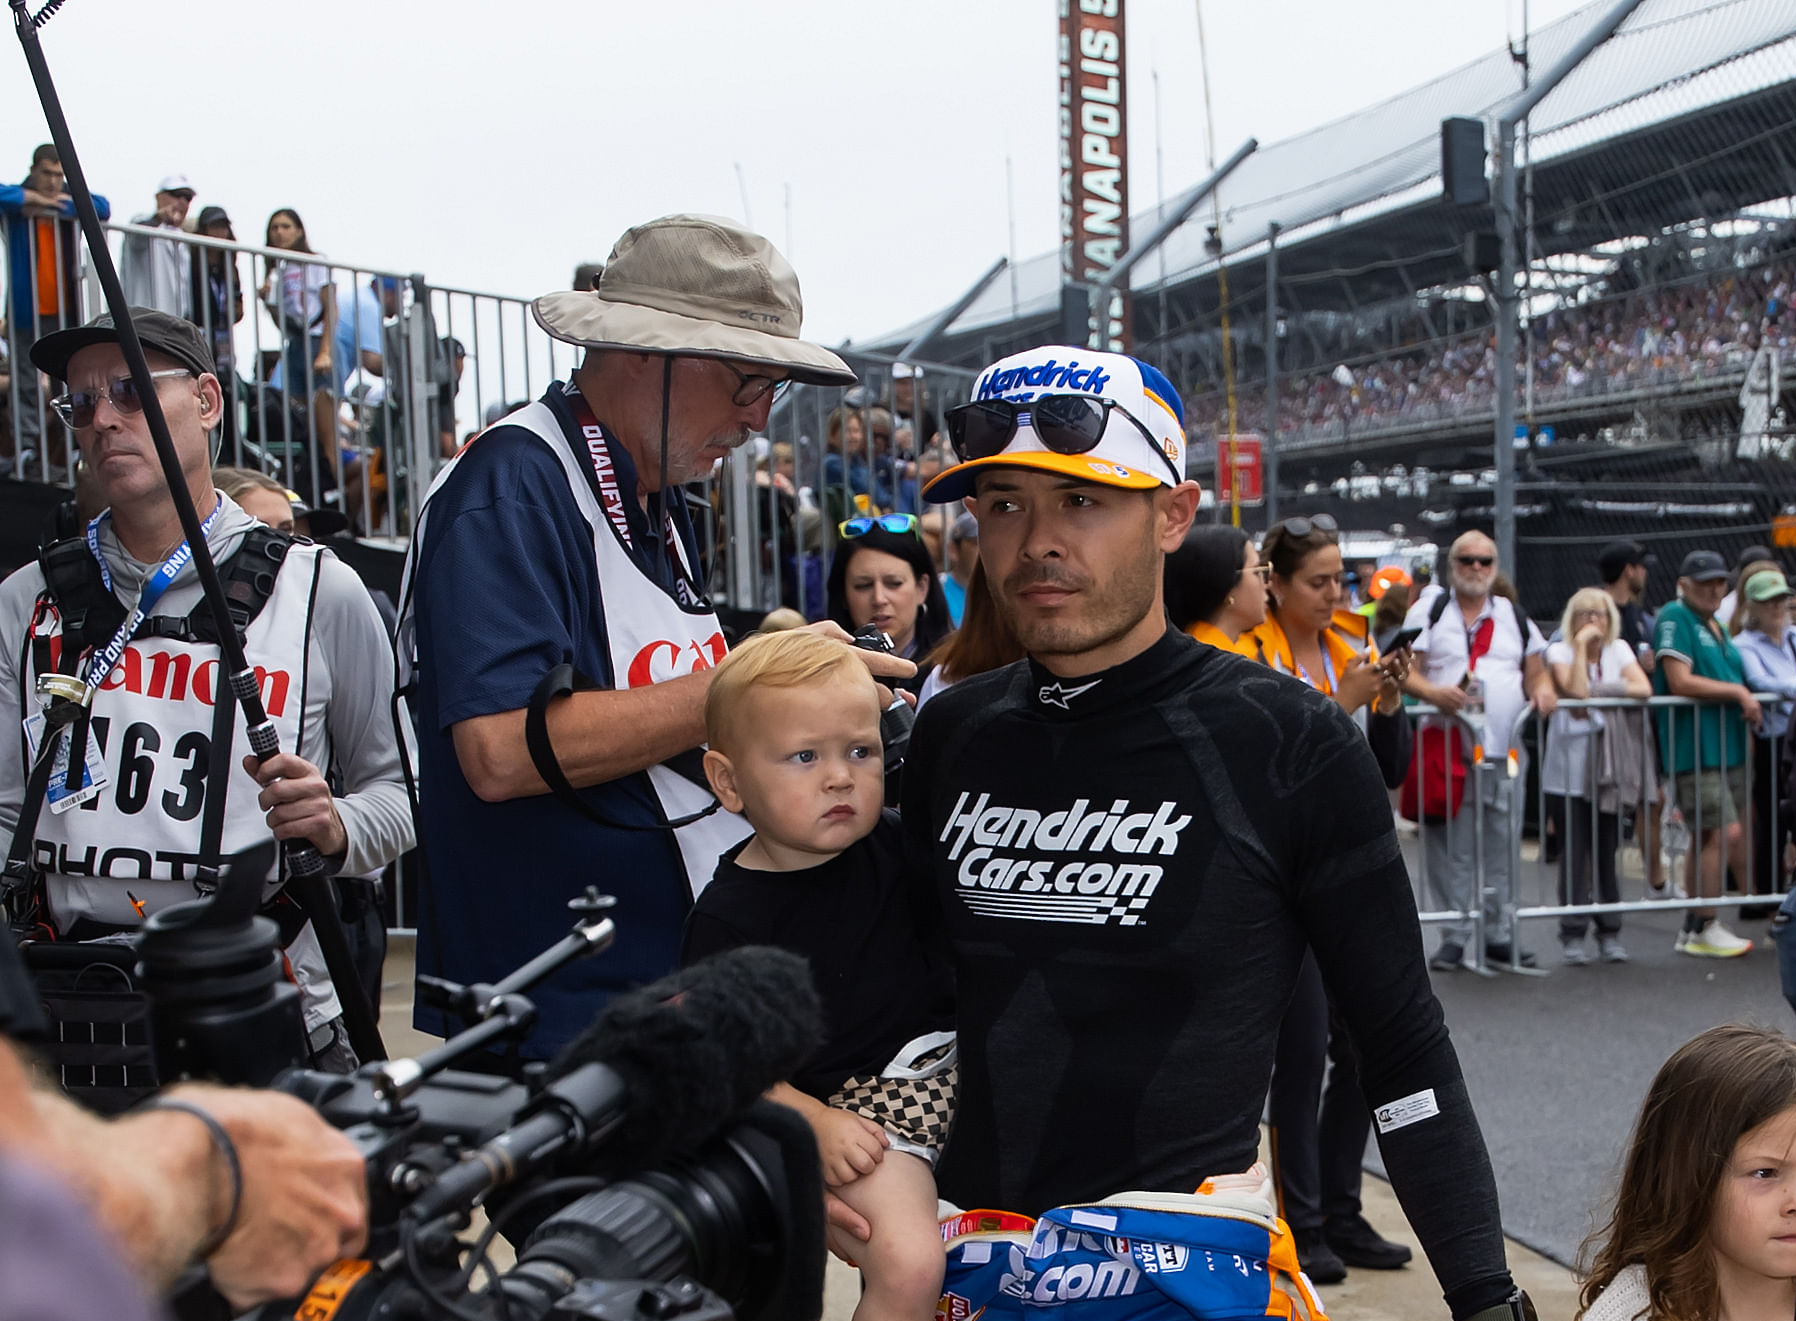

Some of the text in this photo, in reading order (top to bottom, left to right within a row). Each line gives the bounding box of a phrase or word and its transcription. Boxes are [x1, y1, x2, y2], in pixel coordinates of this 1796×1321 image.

[977, 359, 1110, 400] Hendrick
[581, 424, 634, 550] QUALIFYIN
[86, 662, 111, 690] PRI
[939, 791, 1193, 861] Hendrick
[957, 847, 1164, 897] Cars.com
